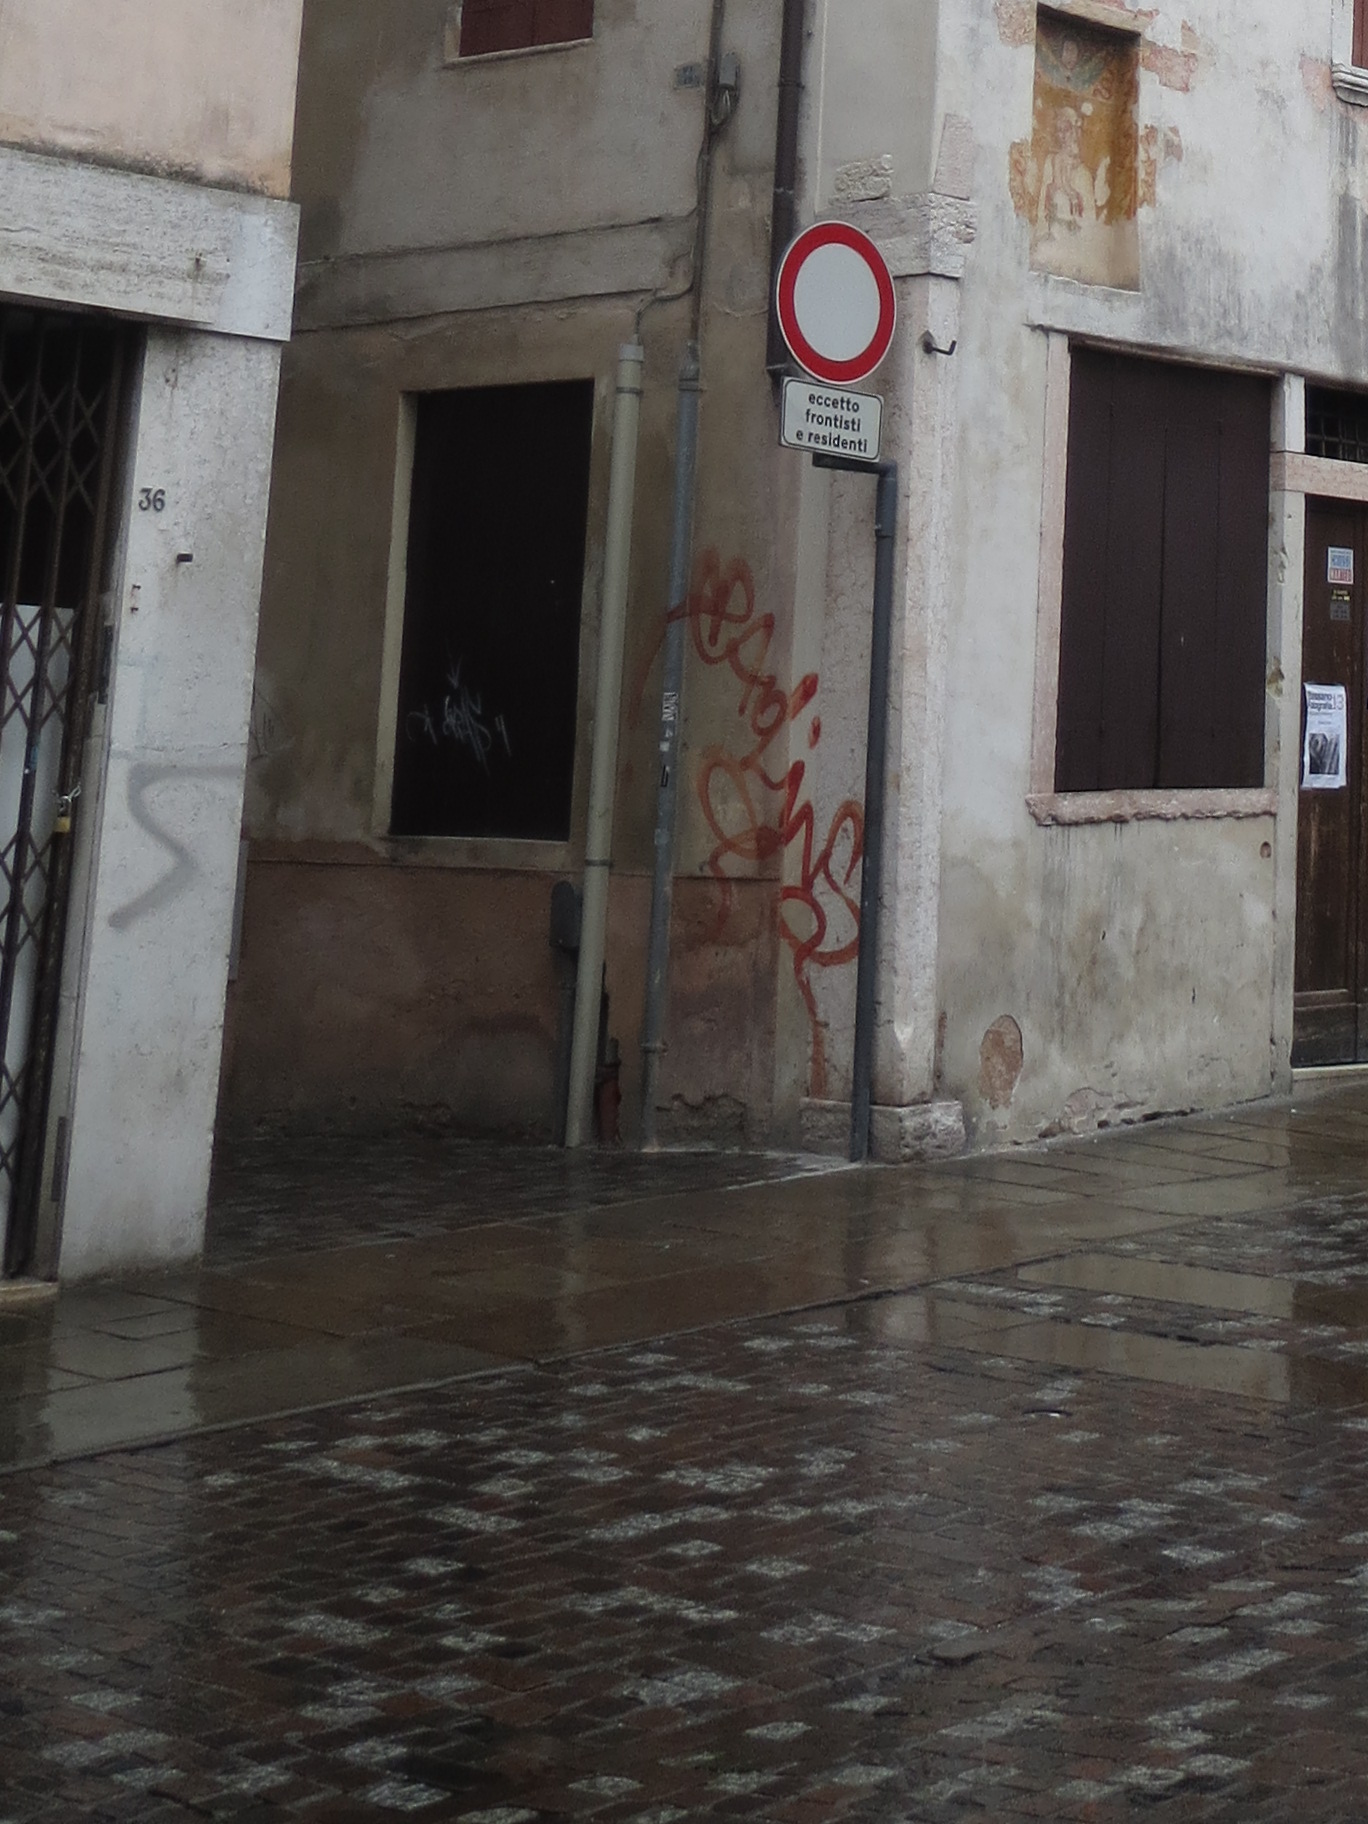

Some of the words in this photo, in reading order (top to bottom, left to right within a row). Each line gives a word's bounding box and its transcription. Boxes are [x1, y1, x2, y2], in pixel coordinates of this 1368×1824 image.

[808, 393, 860, 413] eccetto
[805, 408, 861, 432] frontisti
[796, 430, 804, 441] e
[807, 431, 868, 453] residenti
[138, 487, 166, 513] 36
